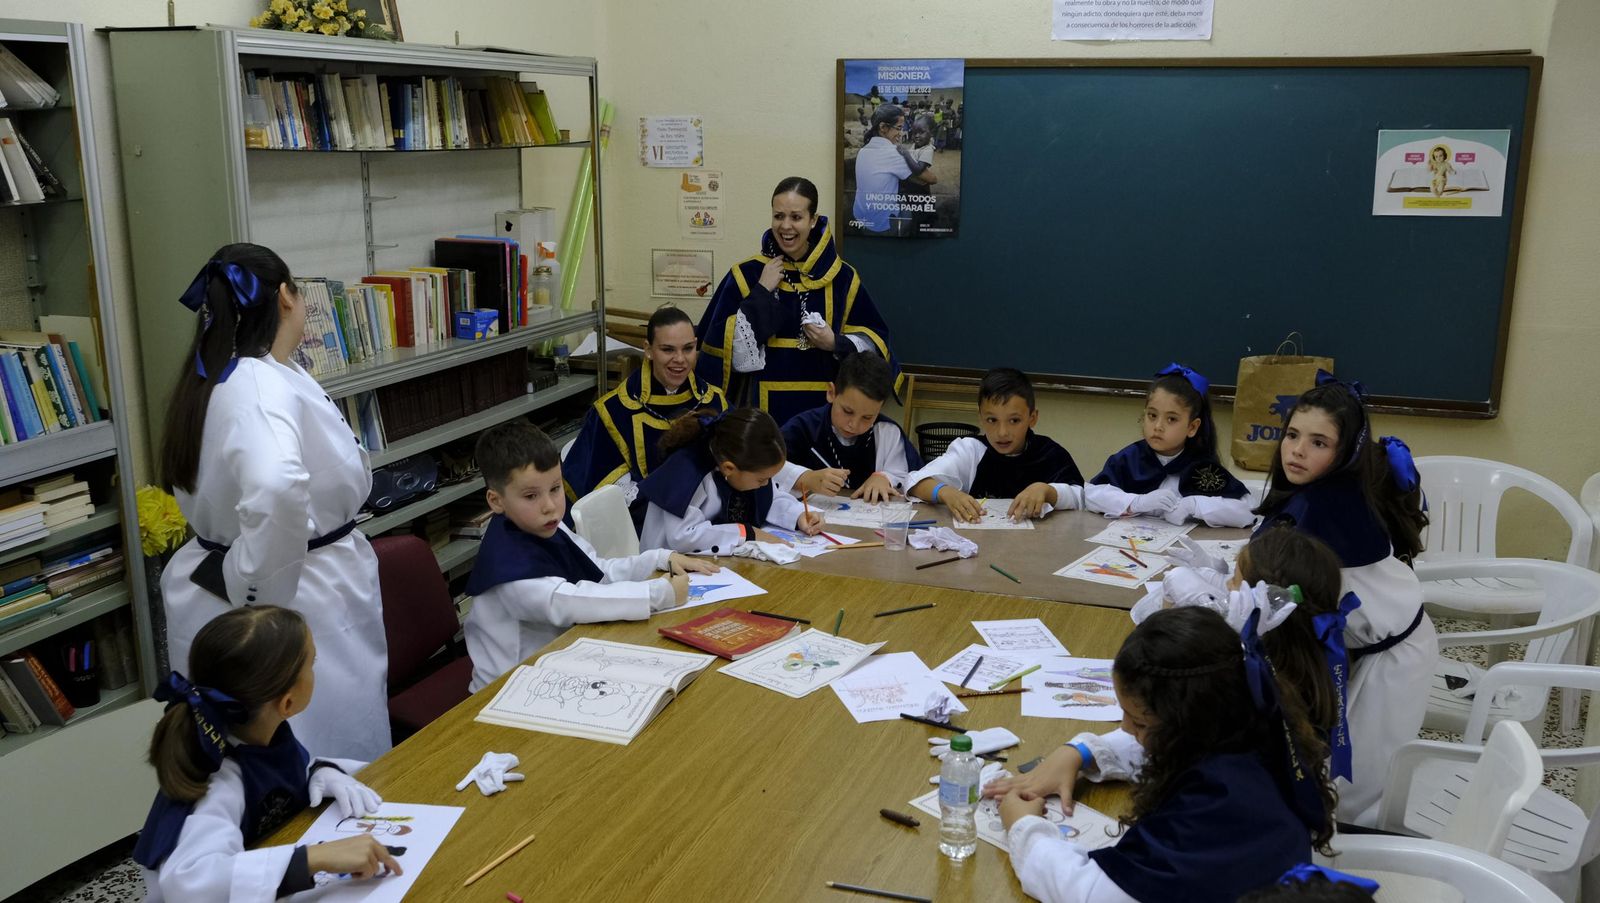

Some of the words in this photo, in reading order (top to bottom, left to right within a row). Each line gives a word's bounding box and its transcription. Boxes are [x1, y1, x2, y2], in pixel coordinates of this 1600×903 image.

[878, 71, 931, 80] MISIONERA
[892, 85, 908, 93] ENERO
[910, 85, 917, 93] DE
[865, 193, 884, 201] UNO
[885, 194, 907, 202] PARA
[907, 195, 937, 203] TODOS
[872, 203, 900, 211] TODOS
[901, 204, 923, 212] PARA
[923, 201, 936, 212] ÉL
